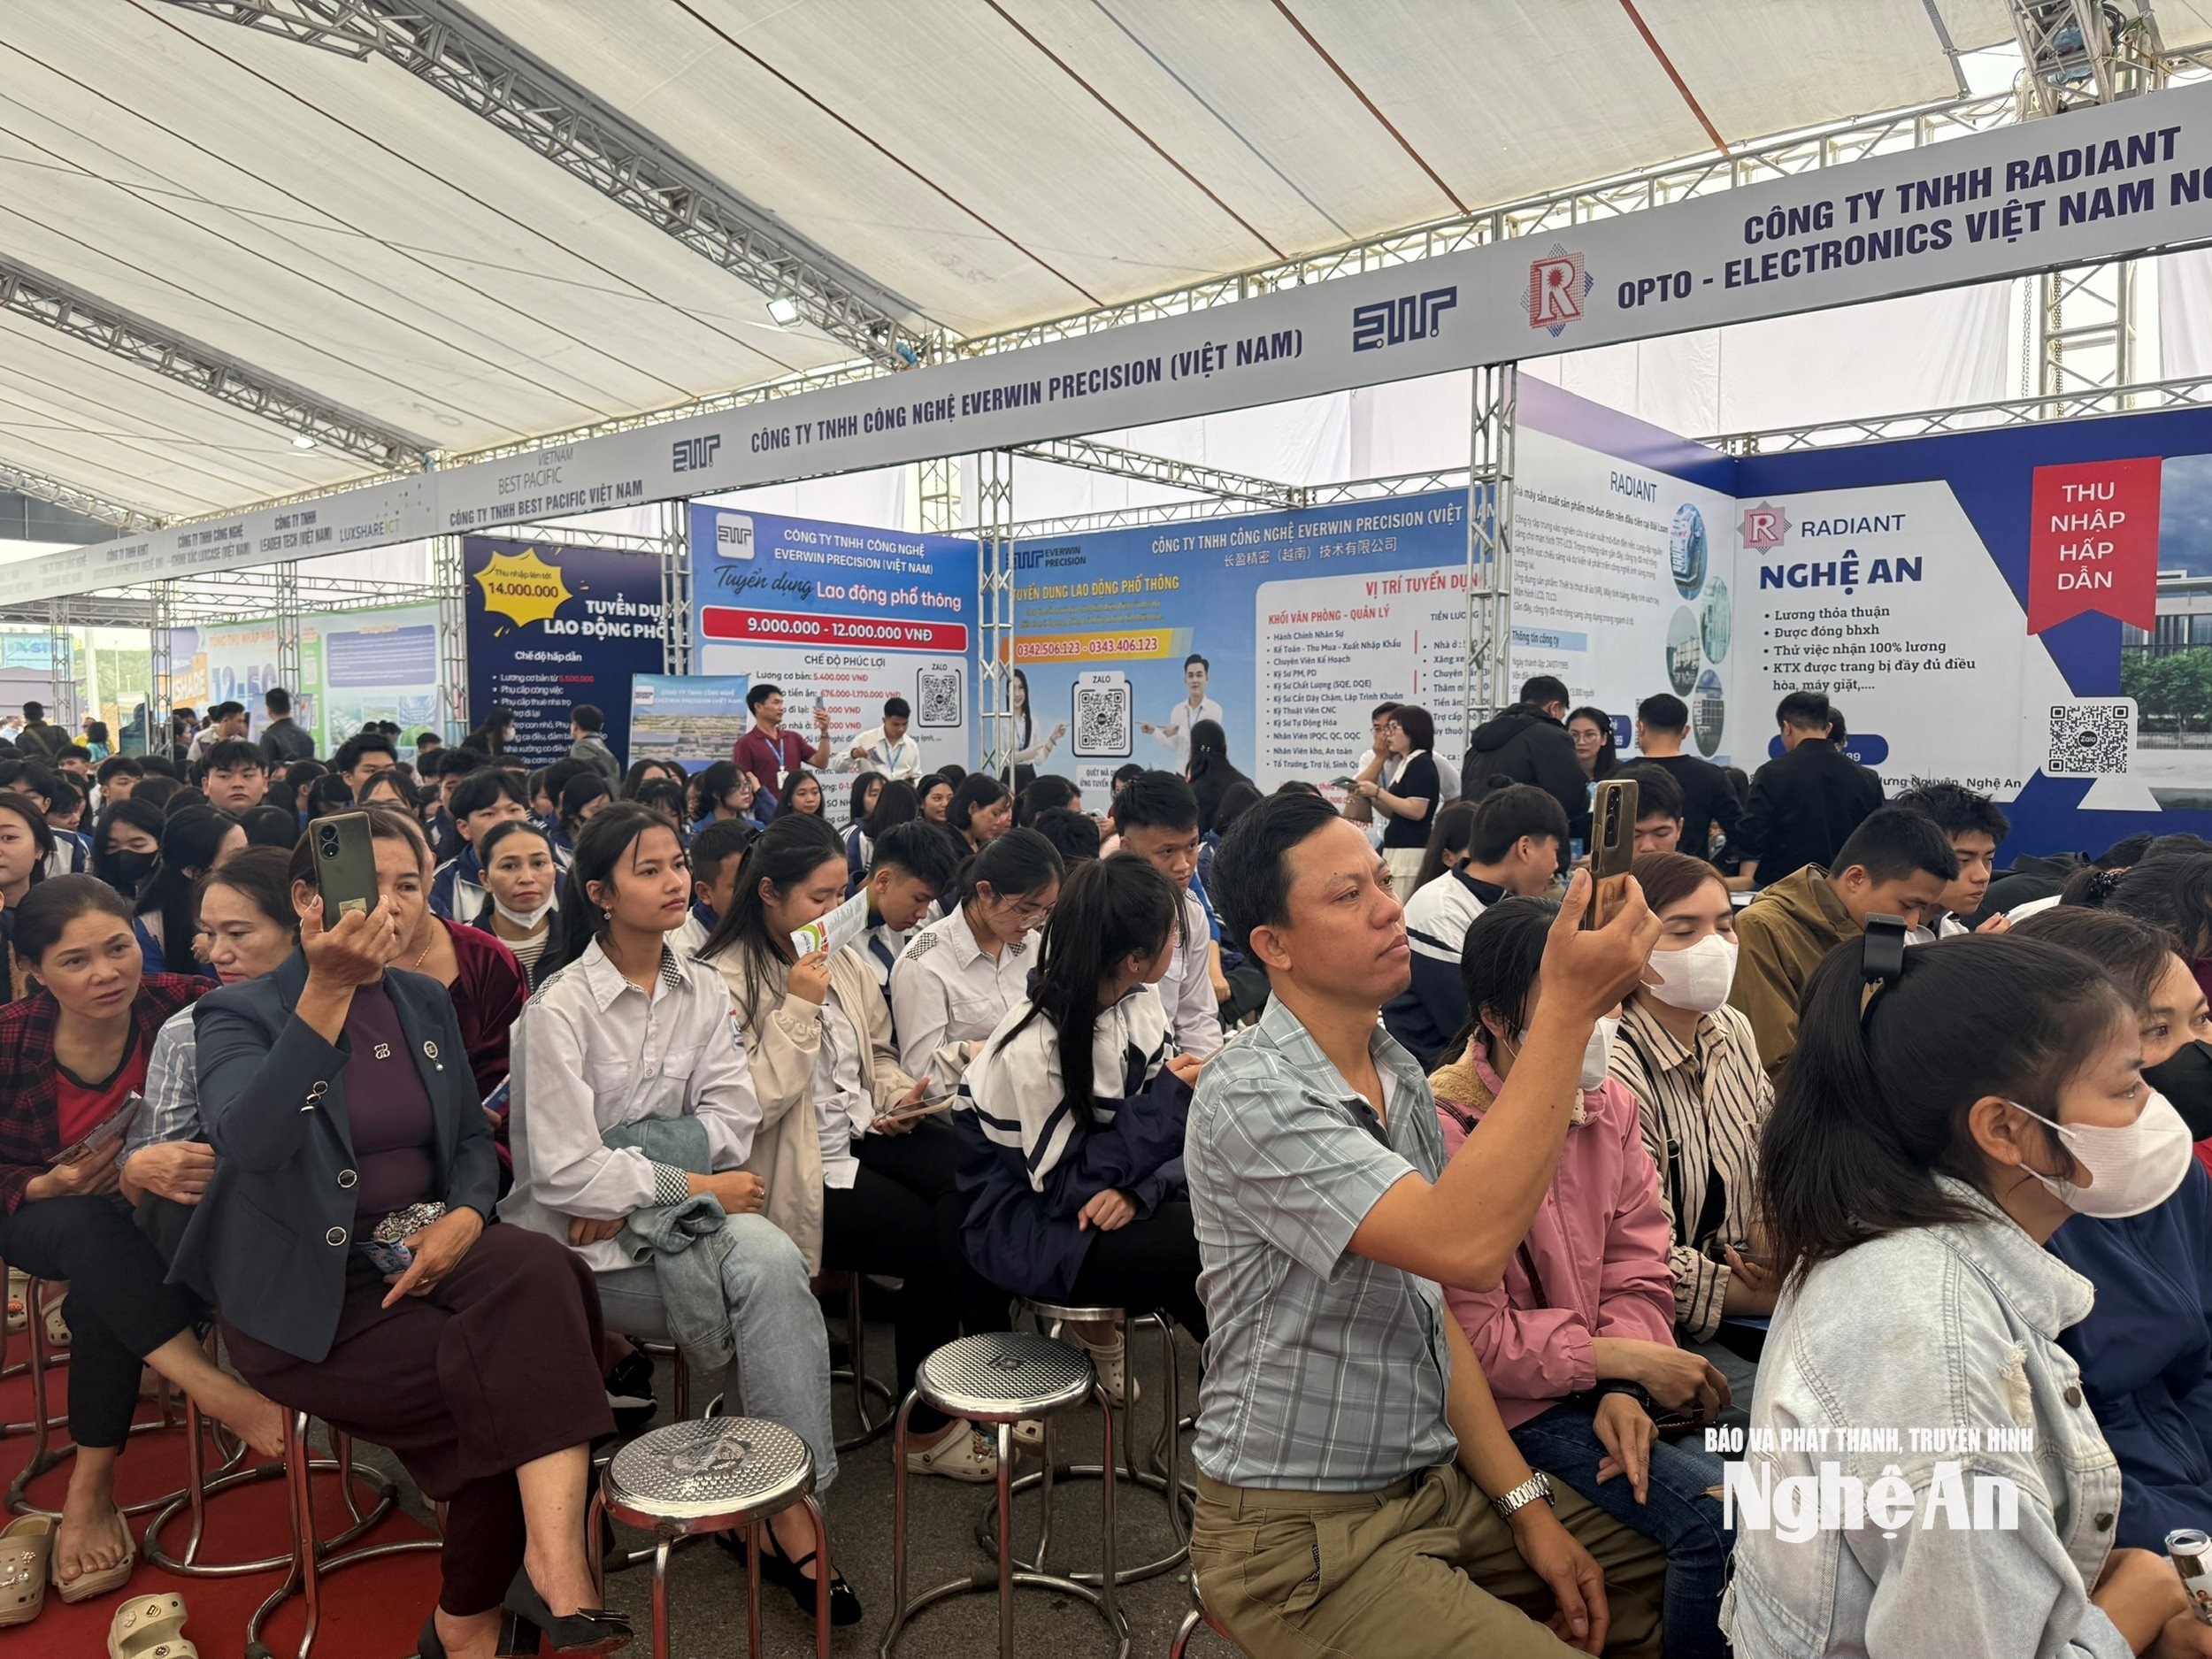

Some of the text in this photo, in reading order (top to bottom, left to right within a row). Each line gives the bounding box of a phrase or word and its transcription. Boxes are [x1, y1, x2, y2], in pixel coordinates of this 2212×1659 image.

[1744, 126, 2181, 245] CÔNG TY TNHH RADIANT
[1617, 267, 1692, 310] OPTO
[1724, 219, 1953, 289] ELECTRONICS
[1965, 198, 2046, 244] VIỆT
[2058, 178, 2156, 227] NAM
[751, 329, 1302, 453] CÔNG TY TNHH CÔNG NGHỆ EVERWIN PRECISION (VIỆT NAM)
[538, 448, 574, 465] VIETNAM
[498, 467, 563, 495] BEST PACIFIC
[1610, 471, 1656, 503] RADIANT
[2062, 482, 2116, 503] THU
[449, 480, 642, 526] CÔNG TY TNHH BEST PACIFIC VIỆT NAM
[340, 522, 384, 542] LUXSHARE
[1152, 503, 1463, 554] CÔNG TY TNHH CÔNG NGHỆ EVERWIN PRECISION (VIỆT
[1801, 513, 1906, 537] RADIANT
[2050, 509, 2126, 533] NHẬP
[784, 528, 925, 559] CÔNG TY TNHH CÔNG NGHỆ
[1045, 546, 1080, 557] EVERWIN
[2059, 536, 2115, 562] HẤP
[775, 548, 933, 575] EVERWIN PRECISION (VIỆT NAM)
[1045, 557, 1087, 567] PRECISION
[1759, 549, 1923, 595] NGHỆ AN
[488, 582, 558, 598] 14.000.000
[714, 565, 814, 600] Tuyển dụng
[1043, 585, 1068, 603] DỤNG
[1071, 583, 1088, 597] LAO
[1092, 579, 1118, 598] ĐỘNG
[1121, 573, 1143, 593] PHỔ
[1144, 573, 1179, 590] THÔNG
[1365, 581, 1378, 598] VỊ
[1382, 575, 1402, 595] TRÍ
[1406, 571, 1446, 593] TUYỂN
[2057, 569, 2113, 591] DẪN
[586, 592, 636, 616] TUYỂN
[817, 581, 962, 611] Lao động phổ thông
[1269, 611, 1288, 625] KHỐI
[1291, 611, 1309, 624] VĂN
[1311, 609, 1341, 623] PHÒNG
[1350, 605, 1376, 621] QUẢN
[1379, 603, 1390, 618] LÝ
[1774, 604, 1891, 622] Lương thỏa thuận
[544, 619, 579, 634] LAO
[581, 616, 631, 641] ĐỘNG
[748, 618, 820, 636] 9.000.000
[832, 623, 902, 640] 12.000.000
[903, 628, 933, 641] VNĐ
[1512, 630, 1530, 644] Thông
[1774, 623, 1879, 640] Được đóng bhxh
[515, 650, 534, 661] Chế
[534, 650, 546, 664] độ
[547, 651, 565, 664] hấp
[1018, 641, 1080, 657] 0342.506.123
[1089, 637, 1158, 653] 0343.406.123
[1774, 640, 1947, 656] Thử việc nhận 100% lương
[804, 653, 825, 664] CHẾ
[826, 654, 841, 668] ĐỘ
[843, 656, 869, 666] PHÚC
[1773, 657, 1976, 674] KTX được trang bị đầy đủ điều
[757, 672, 782, 681] Lương
[795, 672, 811, 680] bản:
[1772, 678, 1799, 692] hòa,
[1802, 678, 1830, 694] máy
[1967, 777, 2001, 788] Nghệ
[2004, 779, 2022, 788] An
